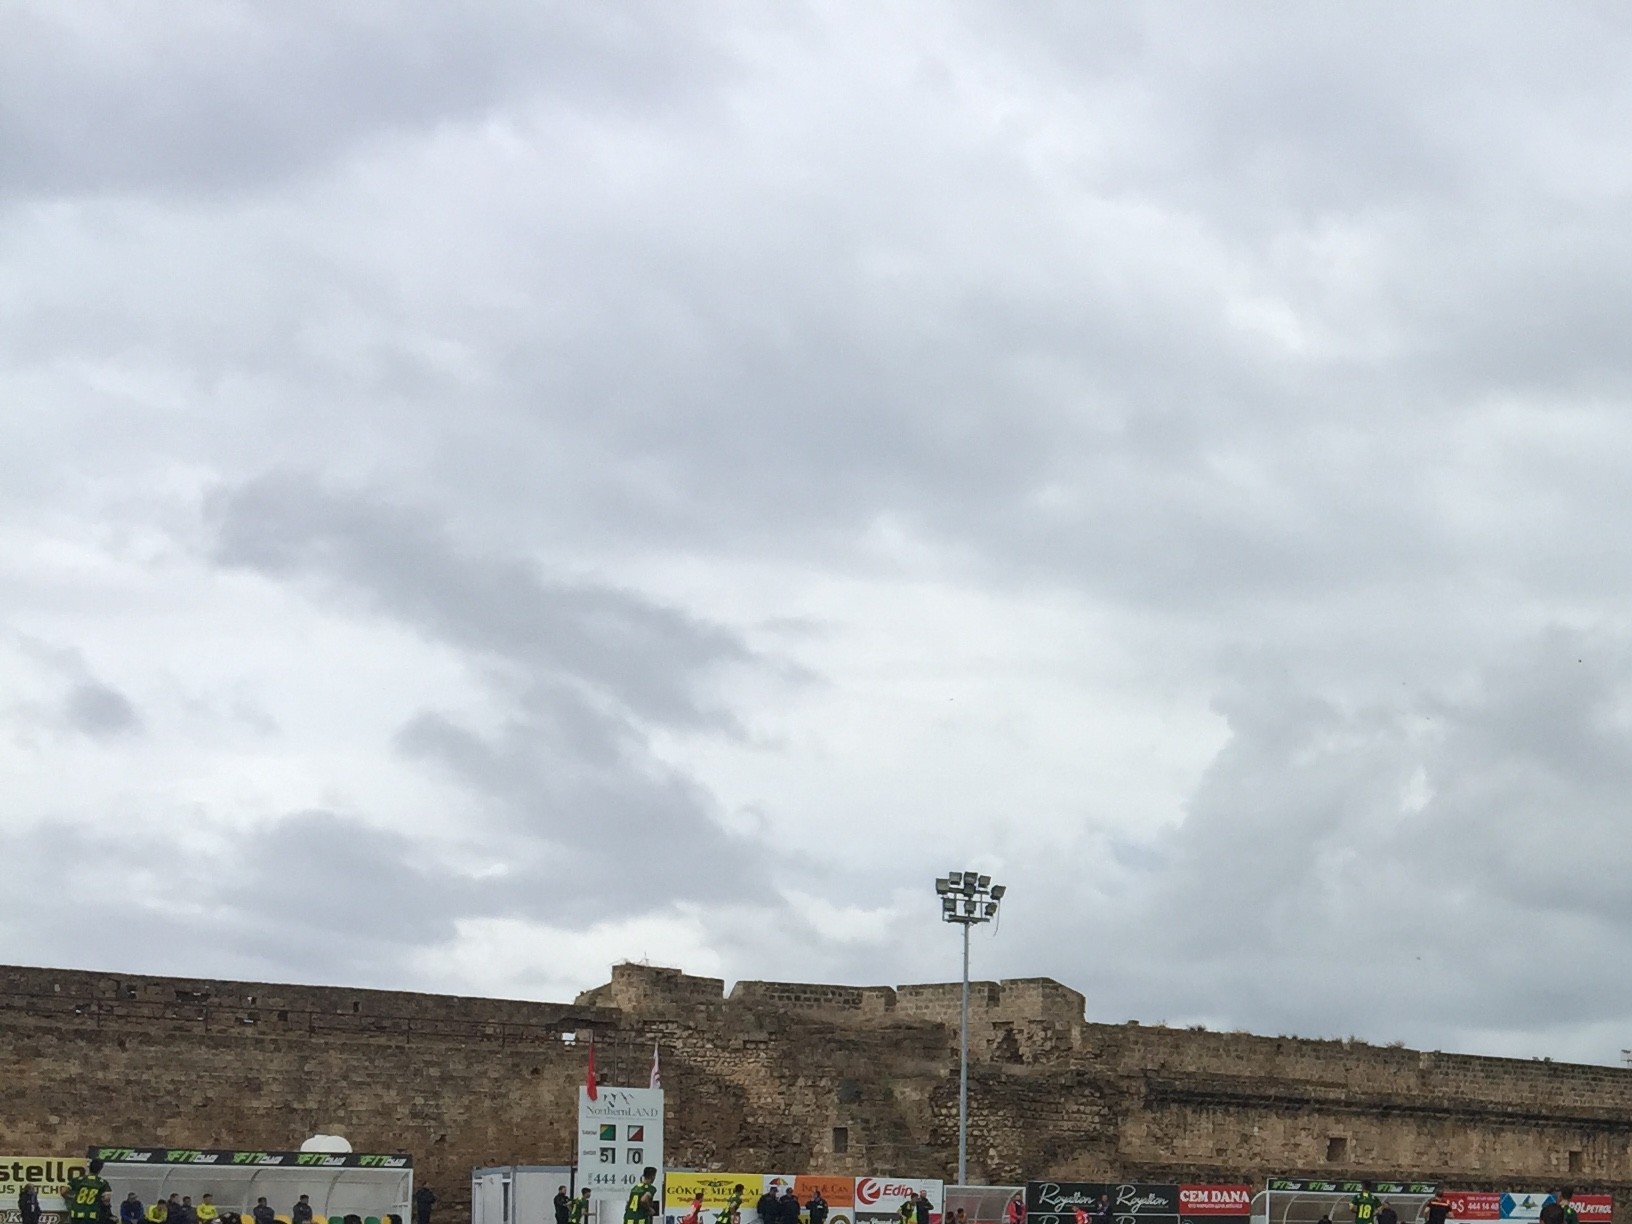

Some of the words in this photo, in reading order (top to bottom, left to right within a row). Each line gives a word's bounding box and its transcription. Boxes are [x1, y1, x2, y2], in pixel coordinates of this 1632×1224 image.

[593, 1173, 616, 1185] 444
[77, 1187, 99, 1205] 88
[882, 1184, 914, 1198] Edip
[1180, 1190, 1209, 1202] CEM
[1211, 1190, 1250, 1203] DANA
[1358, 1204, 1372, 1219] 18
